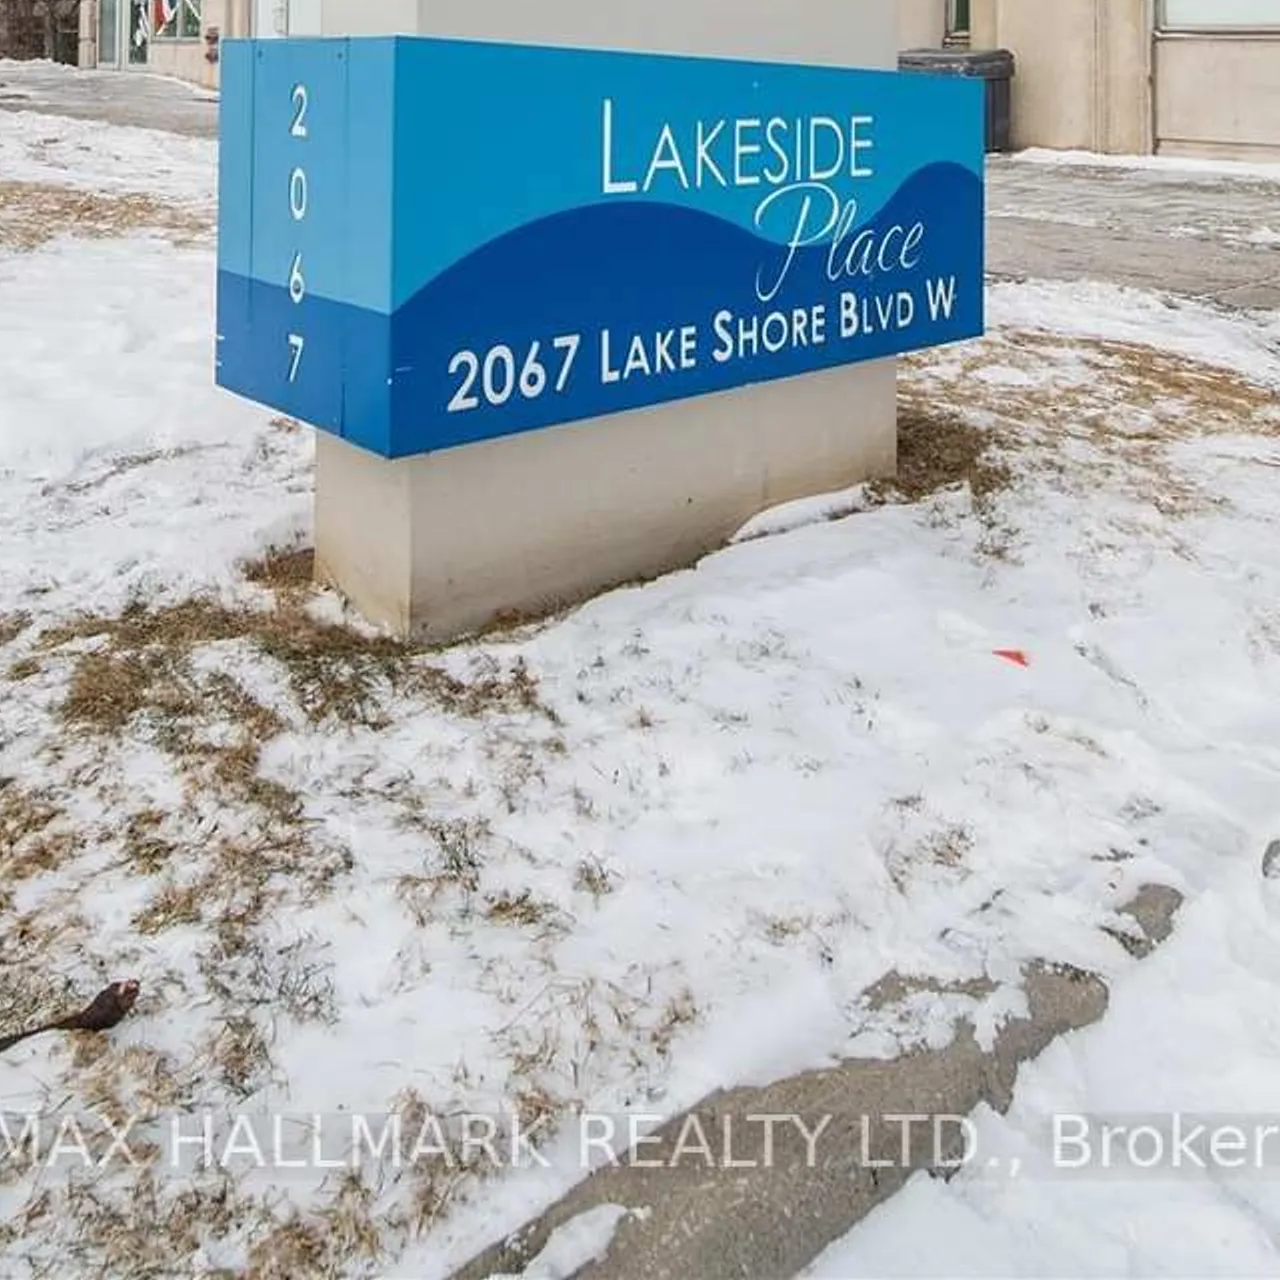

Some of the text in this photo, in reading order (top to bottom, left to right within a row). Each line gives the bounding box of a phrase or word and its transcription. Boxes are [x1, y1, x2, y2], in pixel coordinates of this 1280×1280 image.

[602, 98, 874, 194] LAKESIDE
[753, 181, 925, 303] Place
[446, 274, 957, 413] 2067 LAKE SHORE BLVD W
